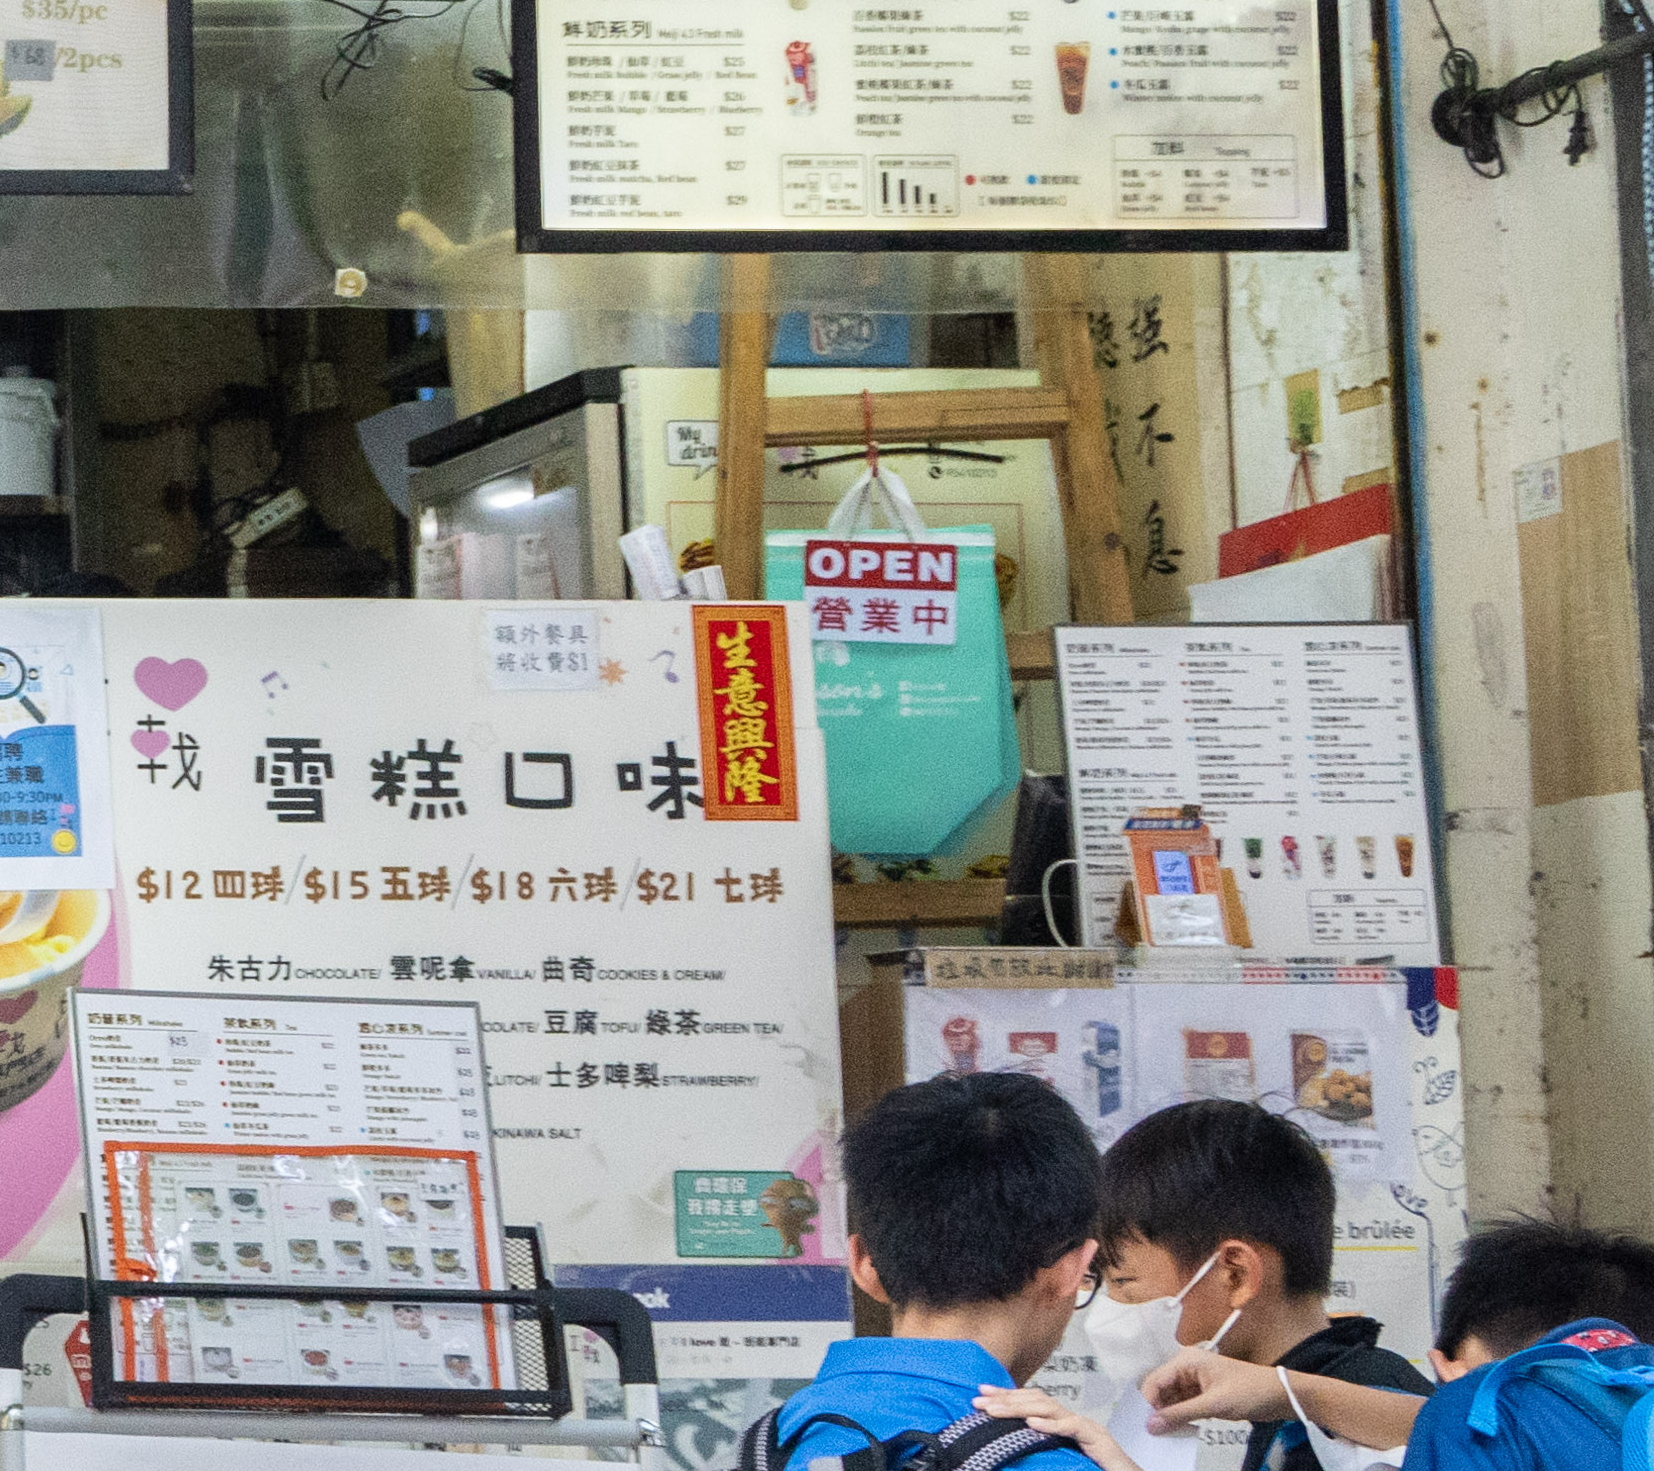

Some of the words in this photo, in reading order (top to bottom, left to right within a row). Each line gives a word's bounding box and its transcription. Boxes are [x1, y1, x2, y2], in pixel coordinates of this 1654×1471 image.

[809, 545, 956, 583] OPEN
[811, 594, 950, 633] 營業中
[714, 621, 779, 803] 生意興隆
[255, 737, 705, 823] 雪糕口味
[138, 869, 201, 903] $12
[305, 868, 370, 903] $15
[470, 868, 535, 903] $18
[637, 870, 695, 903] $21
[715, 870, 784, 903] 七球
